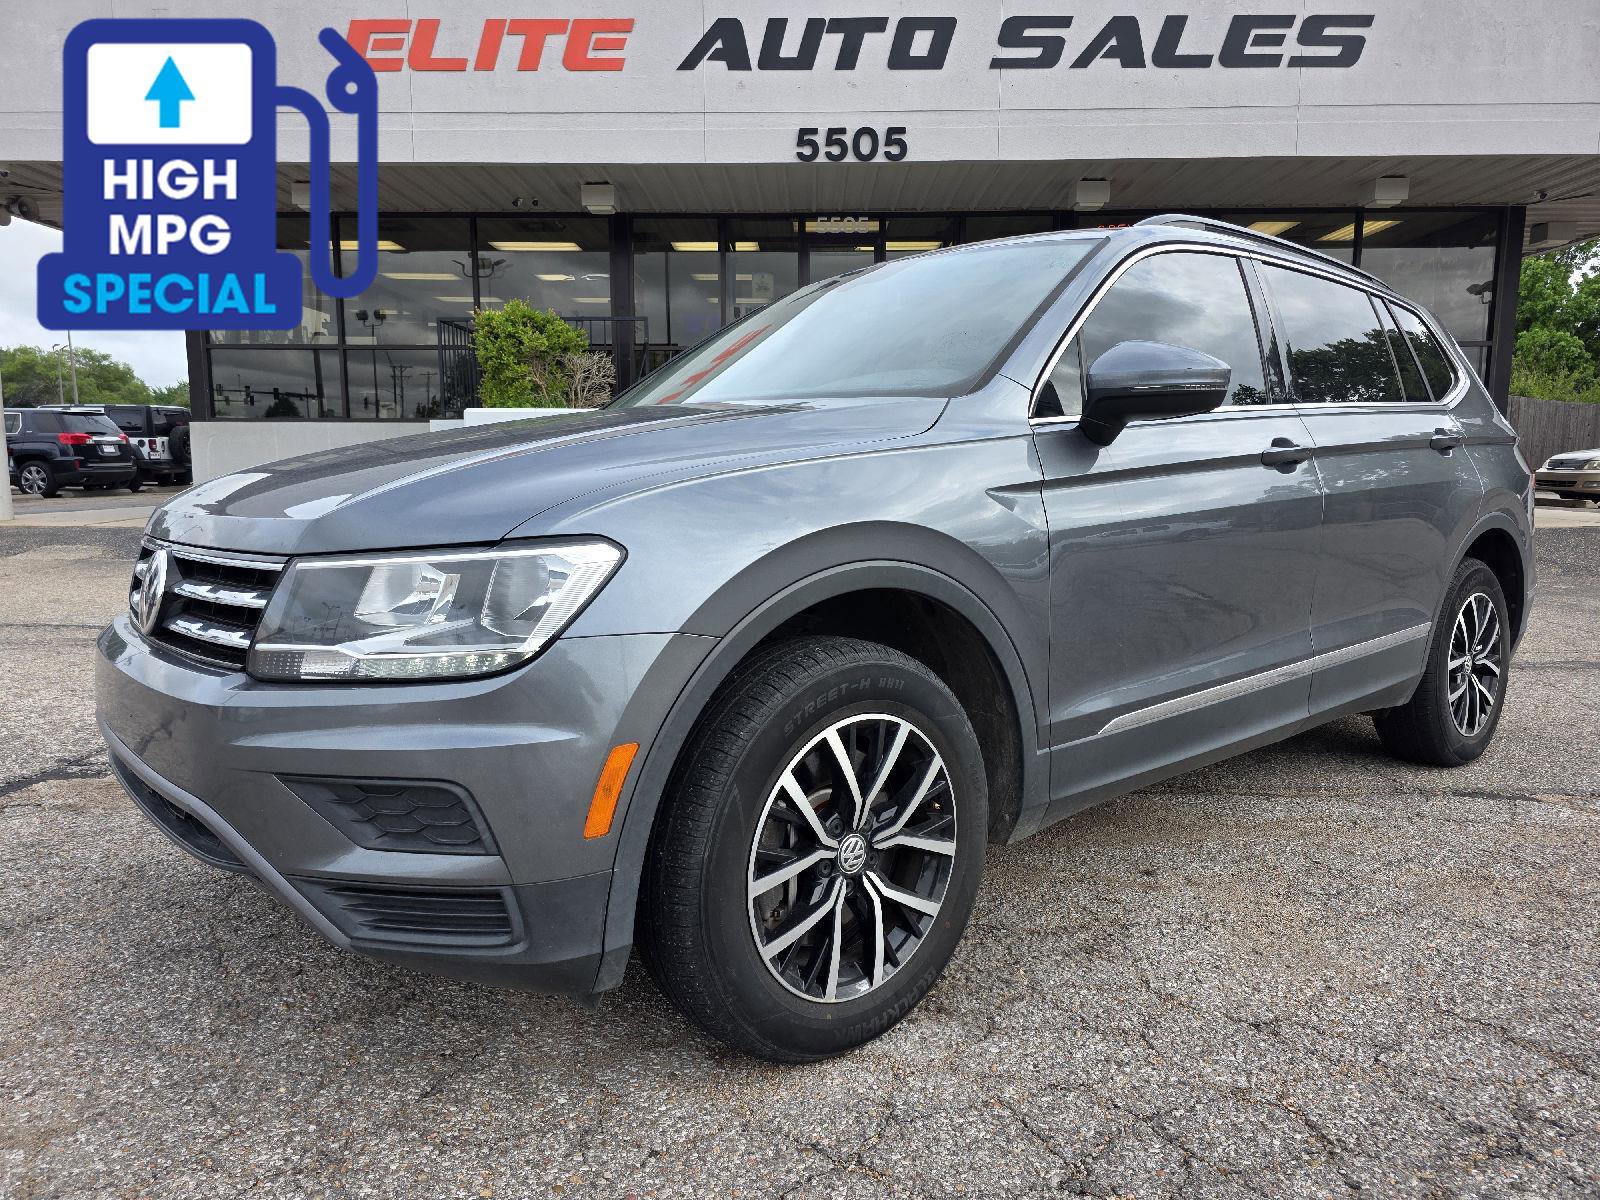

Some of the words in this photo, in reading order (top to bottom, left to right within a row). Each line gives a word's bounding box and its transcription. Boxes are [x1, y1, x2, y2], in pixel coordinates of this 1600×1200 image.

[347, 18, 635, 72] ELITE
[676, 17, 958, 71] AUTO
[989, 14, 1375, 69] SALES
[796, 126, 908, 163] 5505
